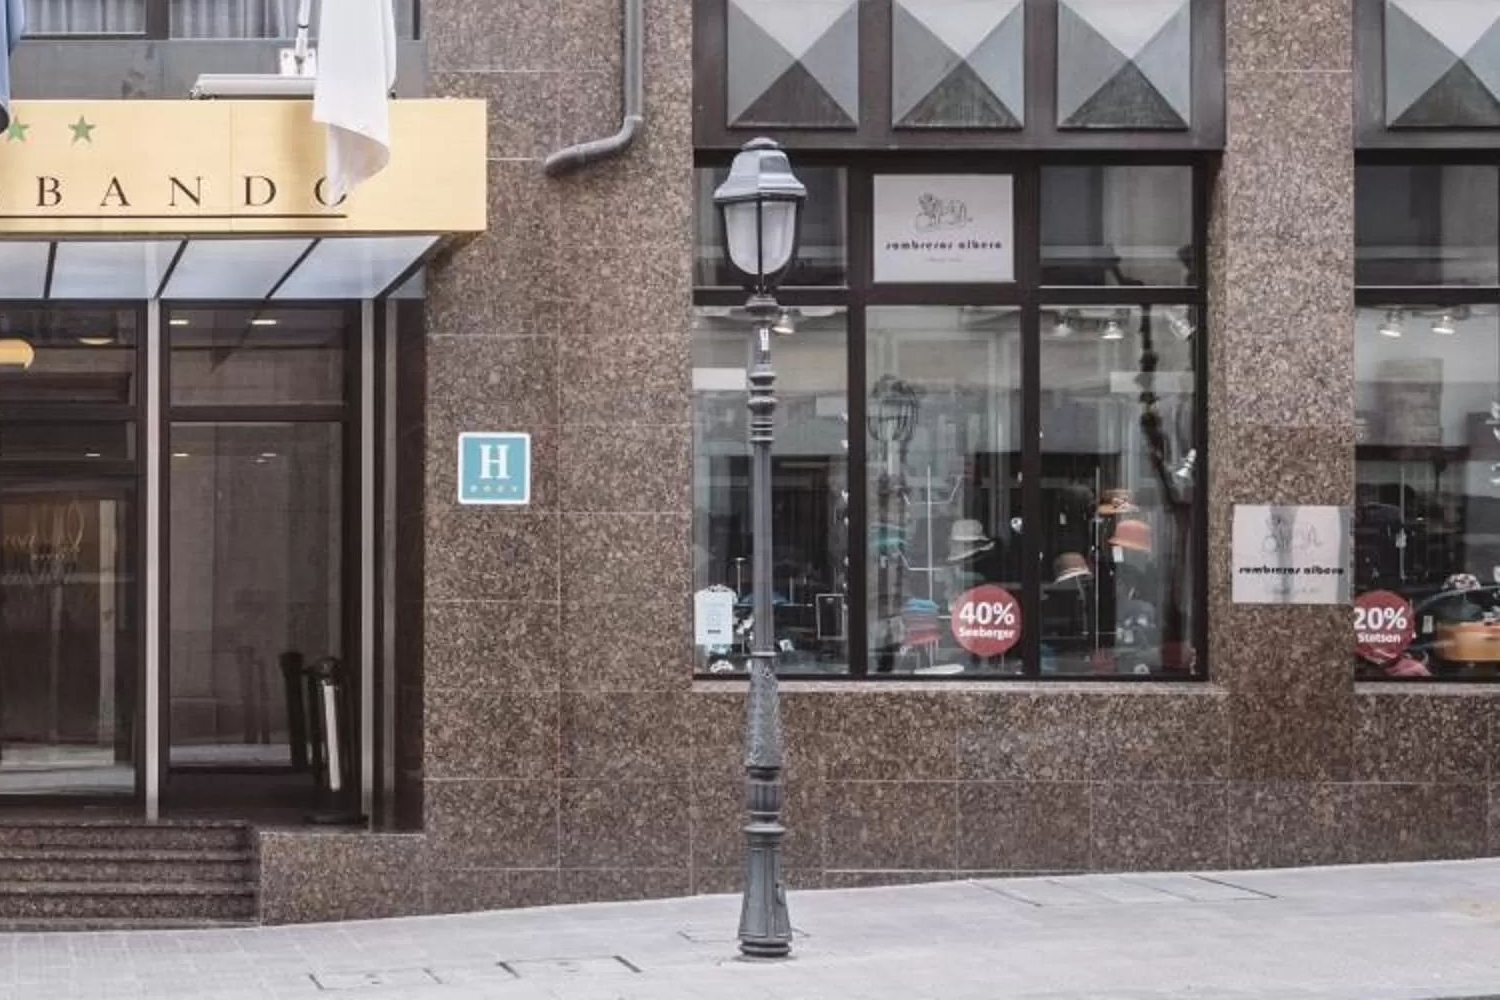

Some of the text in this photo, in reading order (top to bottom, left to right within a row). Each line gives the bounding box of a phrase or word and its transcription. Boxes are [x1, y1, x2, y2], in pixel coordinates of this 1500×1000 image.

[480, 444, 511, 479] H
[959, 602, 1015, 625] 40%
[1353, 605, 1407, 630] 20%
[959, 627, 1016, 640] Seeberger
[1358, 632, 1401, 643] Stetson
